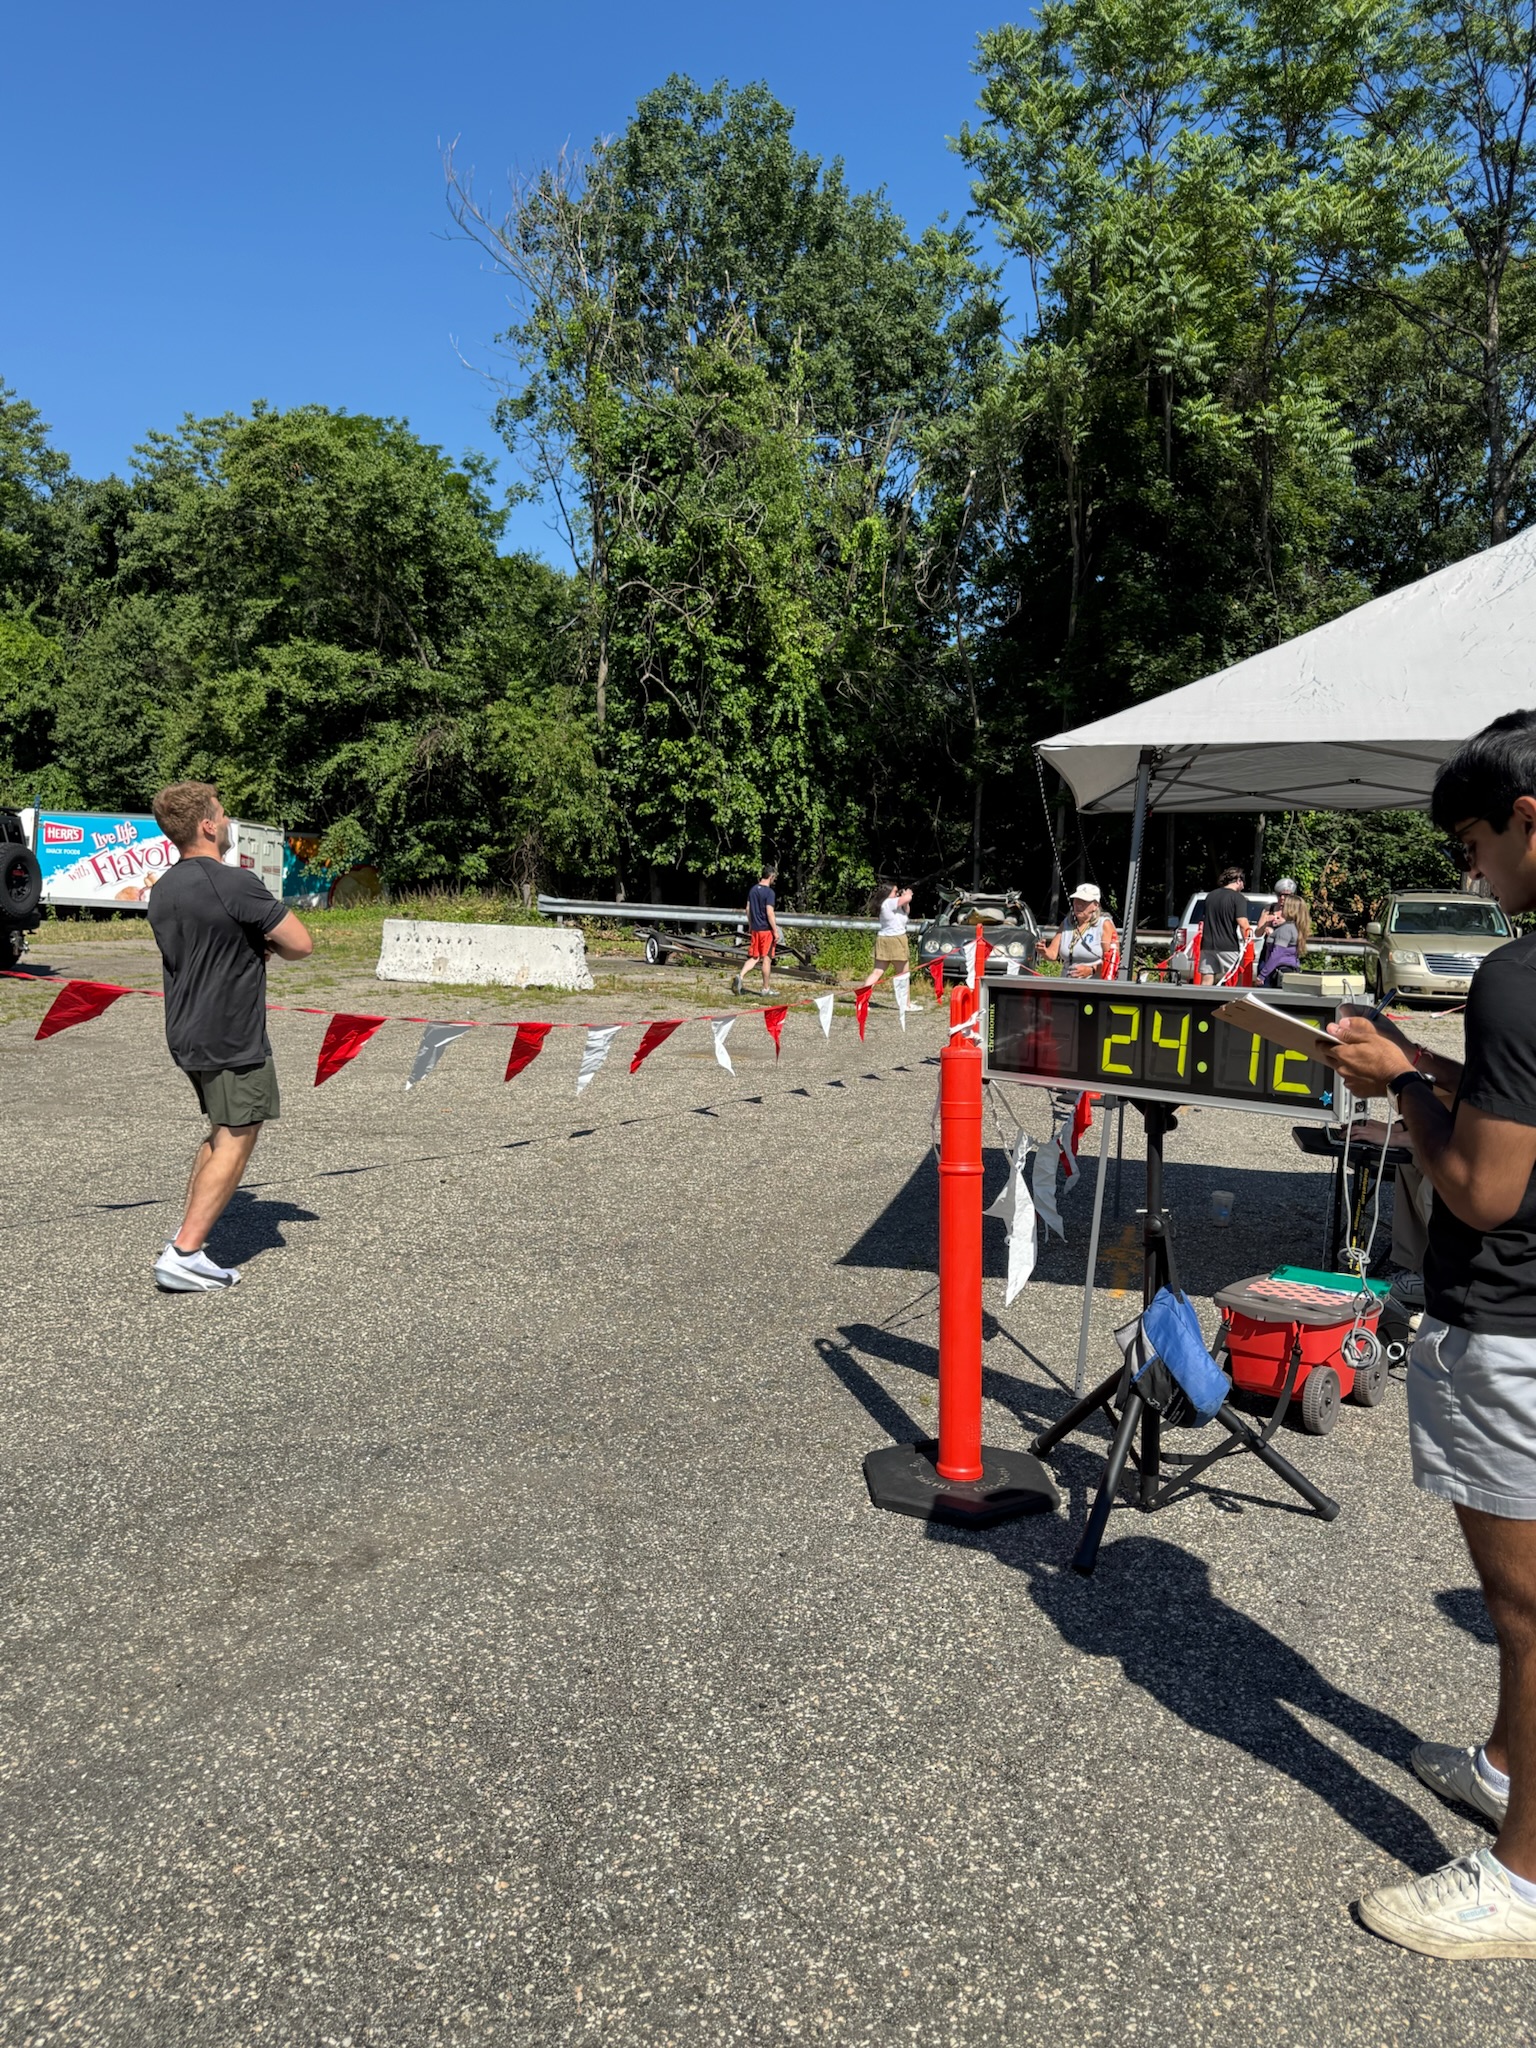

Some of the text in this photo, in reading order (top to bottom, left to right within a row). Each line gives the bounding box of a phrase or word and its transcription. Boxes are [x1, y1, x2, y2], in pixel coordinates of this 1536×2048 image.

[47, 826, 80, 841] HERR'S
[91, 821, 138, 850] Live Life
[68, 840, 174, 886] with Flavor
[987, 1003, 996, 1053] chronomix
